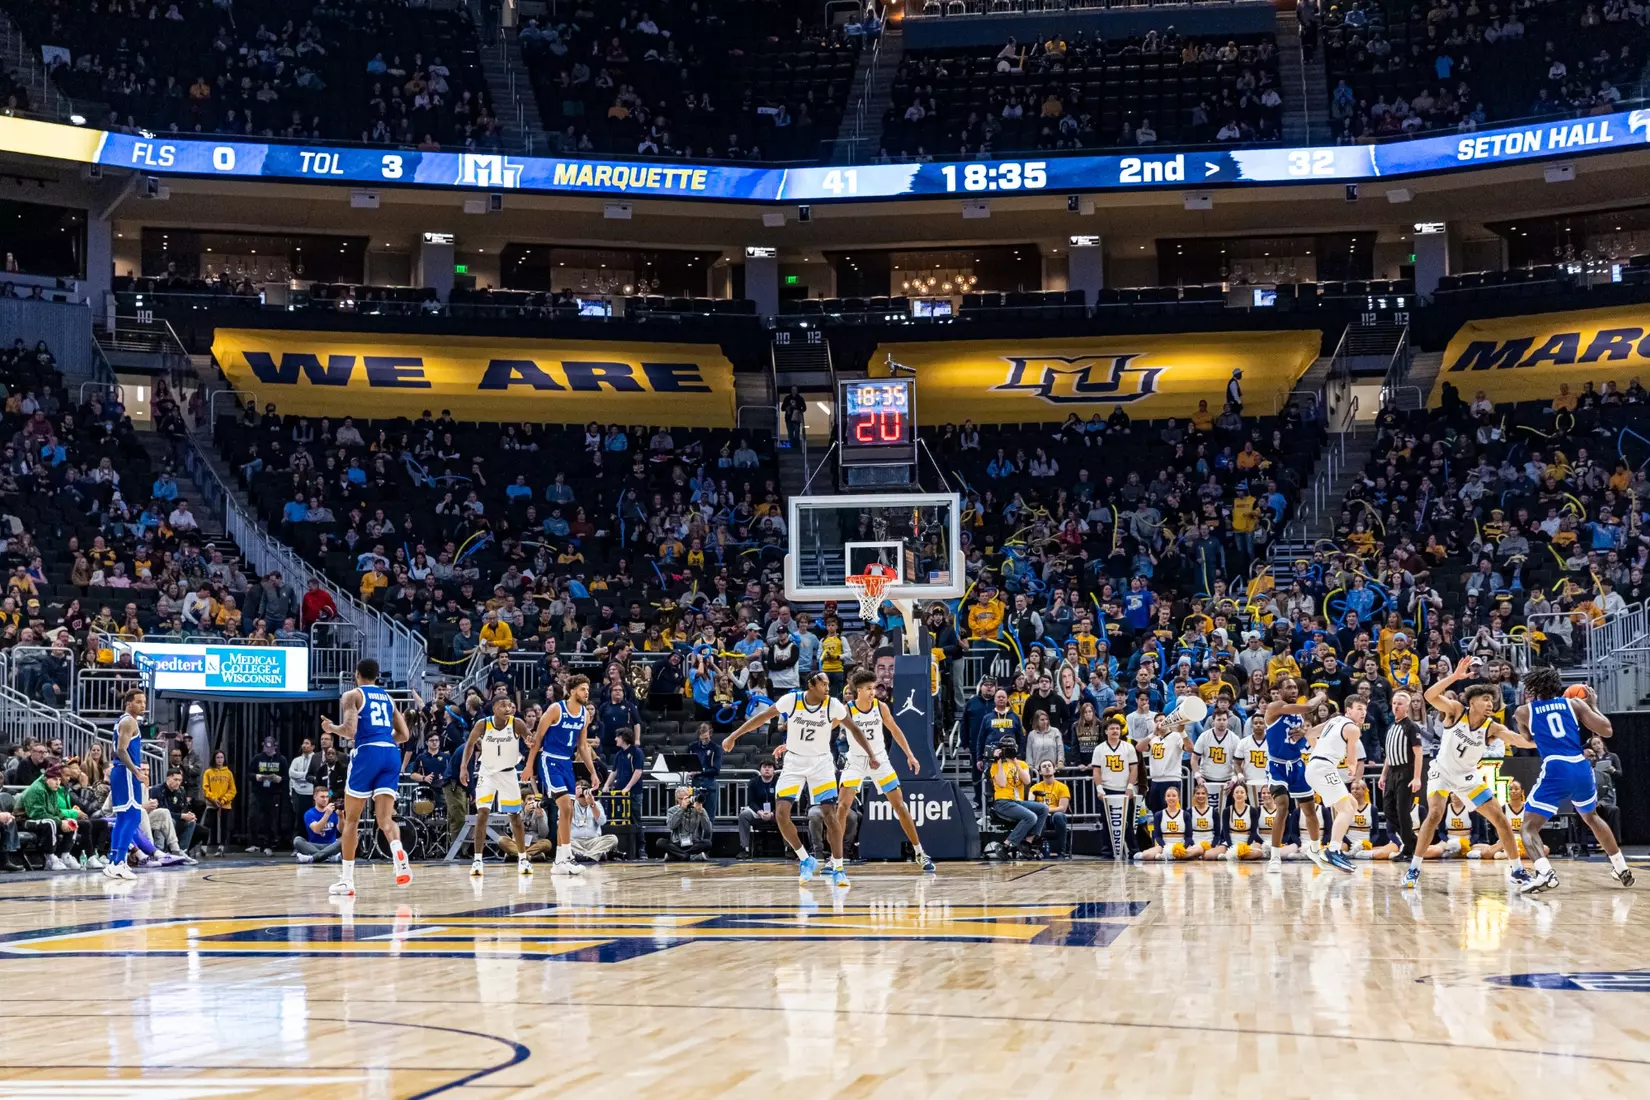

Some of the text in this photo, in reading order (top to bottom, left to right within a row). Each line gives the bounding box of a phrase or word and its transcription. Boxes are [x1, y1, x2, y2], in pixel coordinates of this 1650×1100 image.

[1457, 121, 1614, 162] SETON HALL
[131, 142, 236, 171] FLS 0
[299, 151, 403, 178] TOL 3
[1288, 150, 1335, 177] 32
[553, 164, 858, 194] MARQUETTE 41
[941, 154, 1184, 192] 18:35 2nd
[136, 310, 153, 323] 110
[1361, 312, 1409, 326] 112 113
[775, 331, 822, 344] 110 112
[243, 351, 712, 393] WE ARE
[856, 385, 906, 406] 18:35
[856, 408, 900, 442] 20
[221, 661, 271, 674] COLLEGE
[229, 652, 279, 666] MEDICAL
[221, 671, 282, 684] WISCONSIN
[369, 701, 391, 728] 21
[799, 727, 816, 742] 12
[1546, 712, 1567, 739] 0
[566, 731, 574, 746] 1
[497, 745, 501, 757] 1
[1209, 746, 1227, 764] MU
[1456, 744, 1468, 759] 4
[1105, 755, 1125, 772] MU
